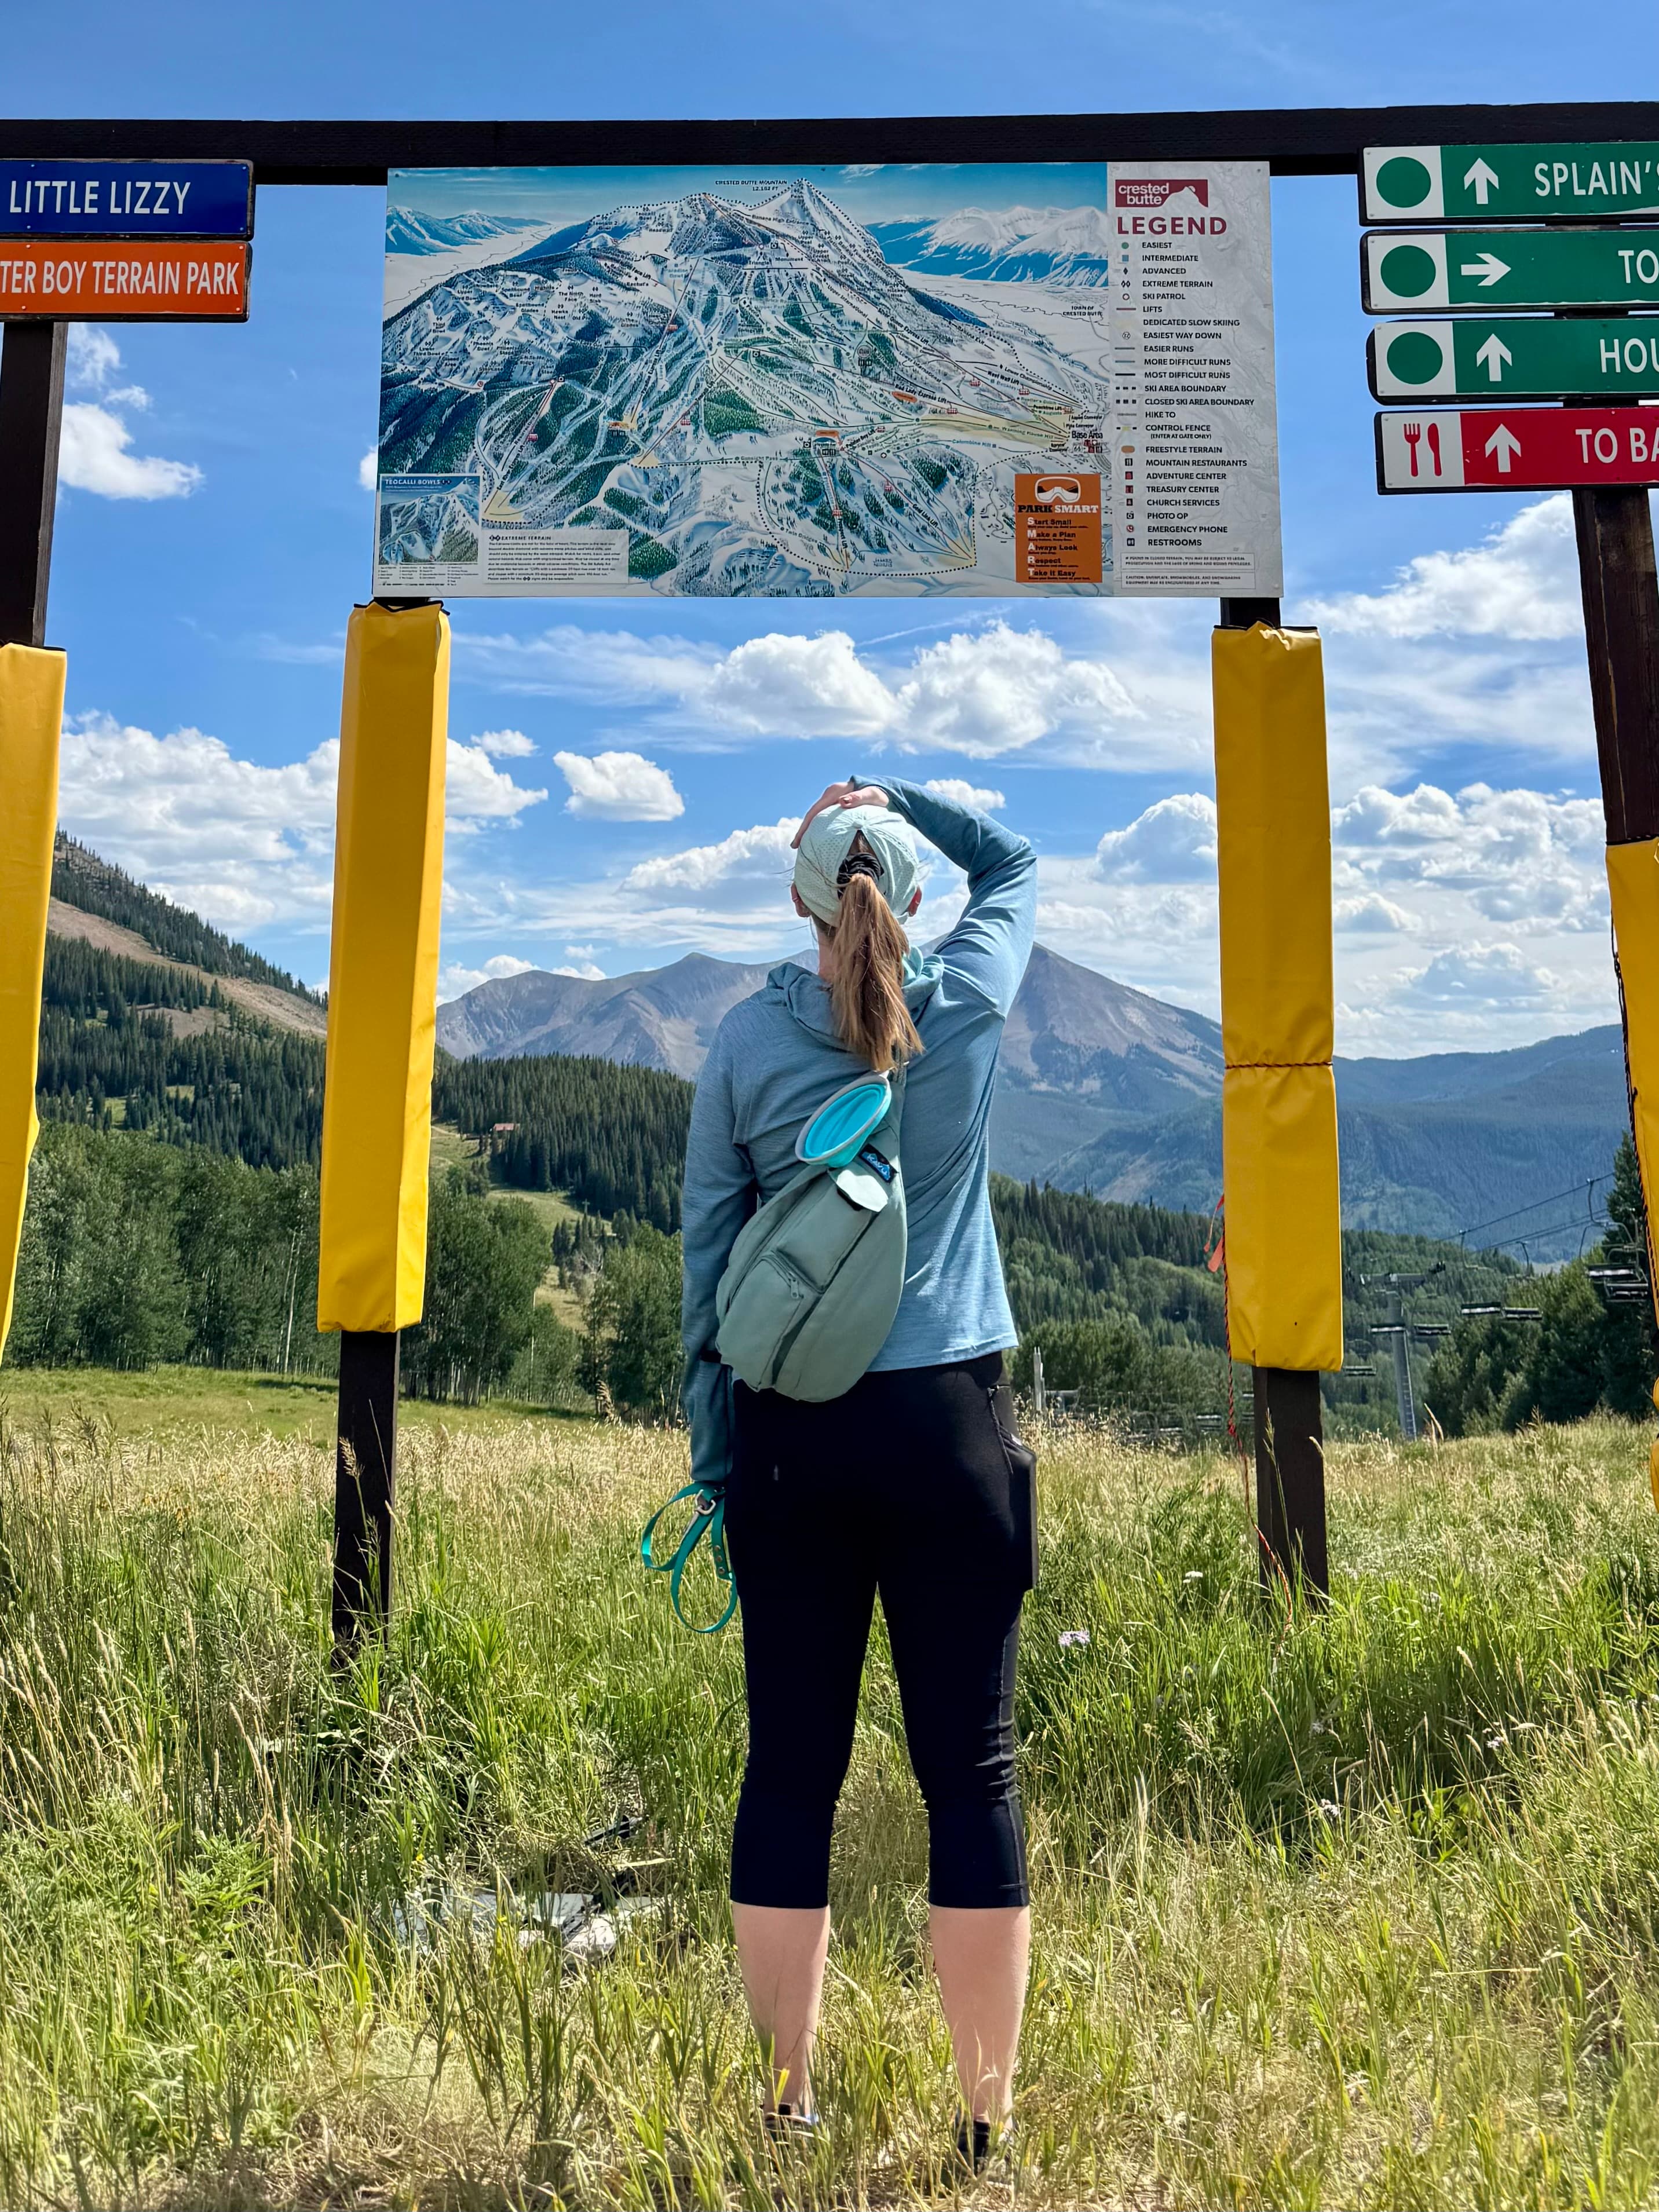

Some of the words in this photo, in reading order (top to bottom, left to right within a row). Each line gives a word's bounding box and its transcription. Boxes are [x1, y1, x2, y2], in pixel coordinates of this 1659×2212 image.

[1534, 161, 1659, 197] SPLAIN'
[1118, 183, 1170, 195] crested
[10, 181, 99, 213] LITTLE
[109, 181, 191, 214] LIZZY
[1127, 194, 1162, 205] butte
[1117, 217, 1227, 235] LEGEND
[1618, 249, 1659, 284] TO
[42, 261, 87, 294] BOY
[93, 262, 180, 294] TERRAIN
[187, 262, 240, 295] PARK
[840, 295, 868, 319] International
[920, 337, 930, 346] Lift
[912, 360, 942, 383] International
[1004, 366, 1019, 376] Lower
[1019, 372, 1053, 390] Championship
[937, 396, 948, 404] Lift
[1002, 426, 1025, 434] Warming
[1072, 430, 1087, 439] Base
[1088, 430, 1103, 439] Area
[952, 438, 981, 447] Columbine
[1576, 428, 1618, 463] TO
[1018, 504, 1053, 513] PARK
[1054, 504, 1099, 513] SMART
[1027, 529, 1050, 538] Make
[1028, 542, 1057, 552] Always
[1028, 555, 1061, 564] Respect
[1028, 568, 1048, 576] Take
